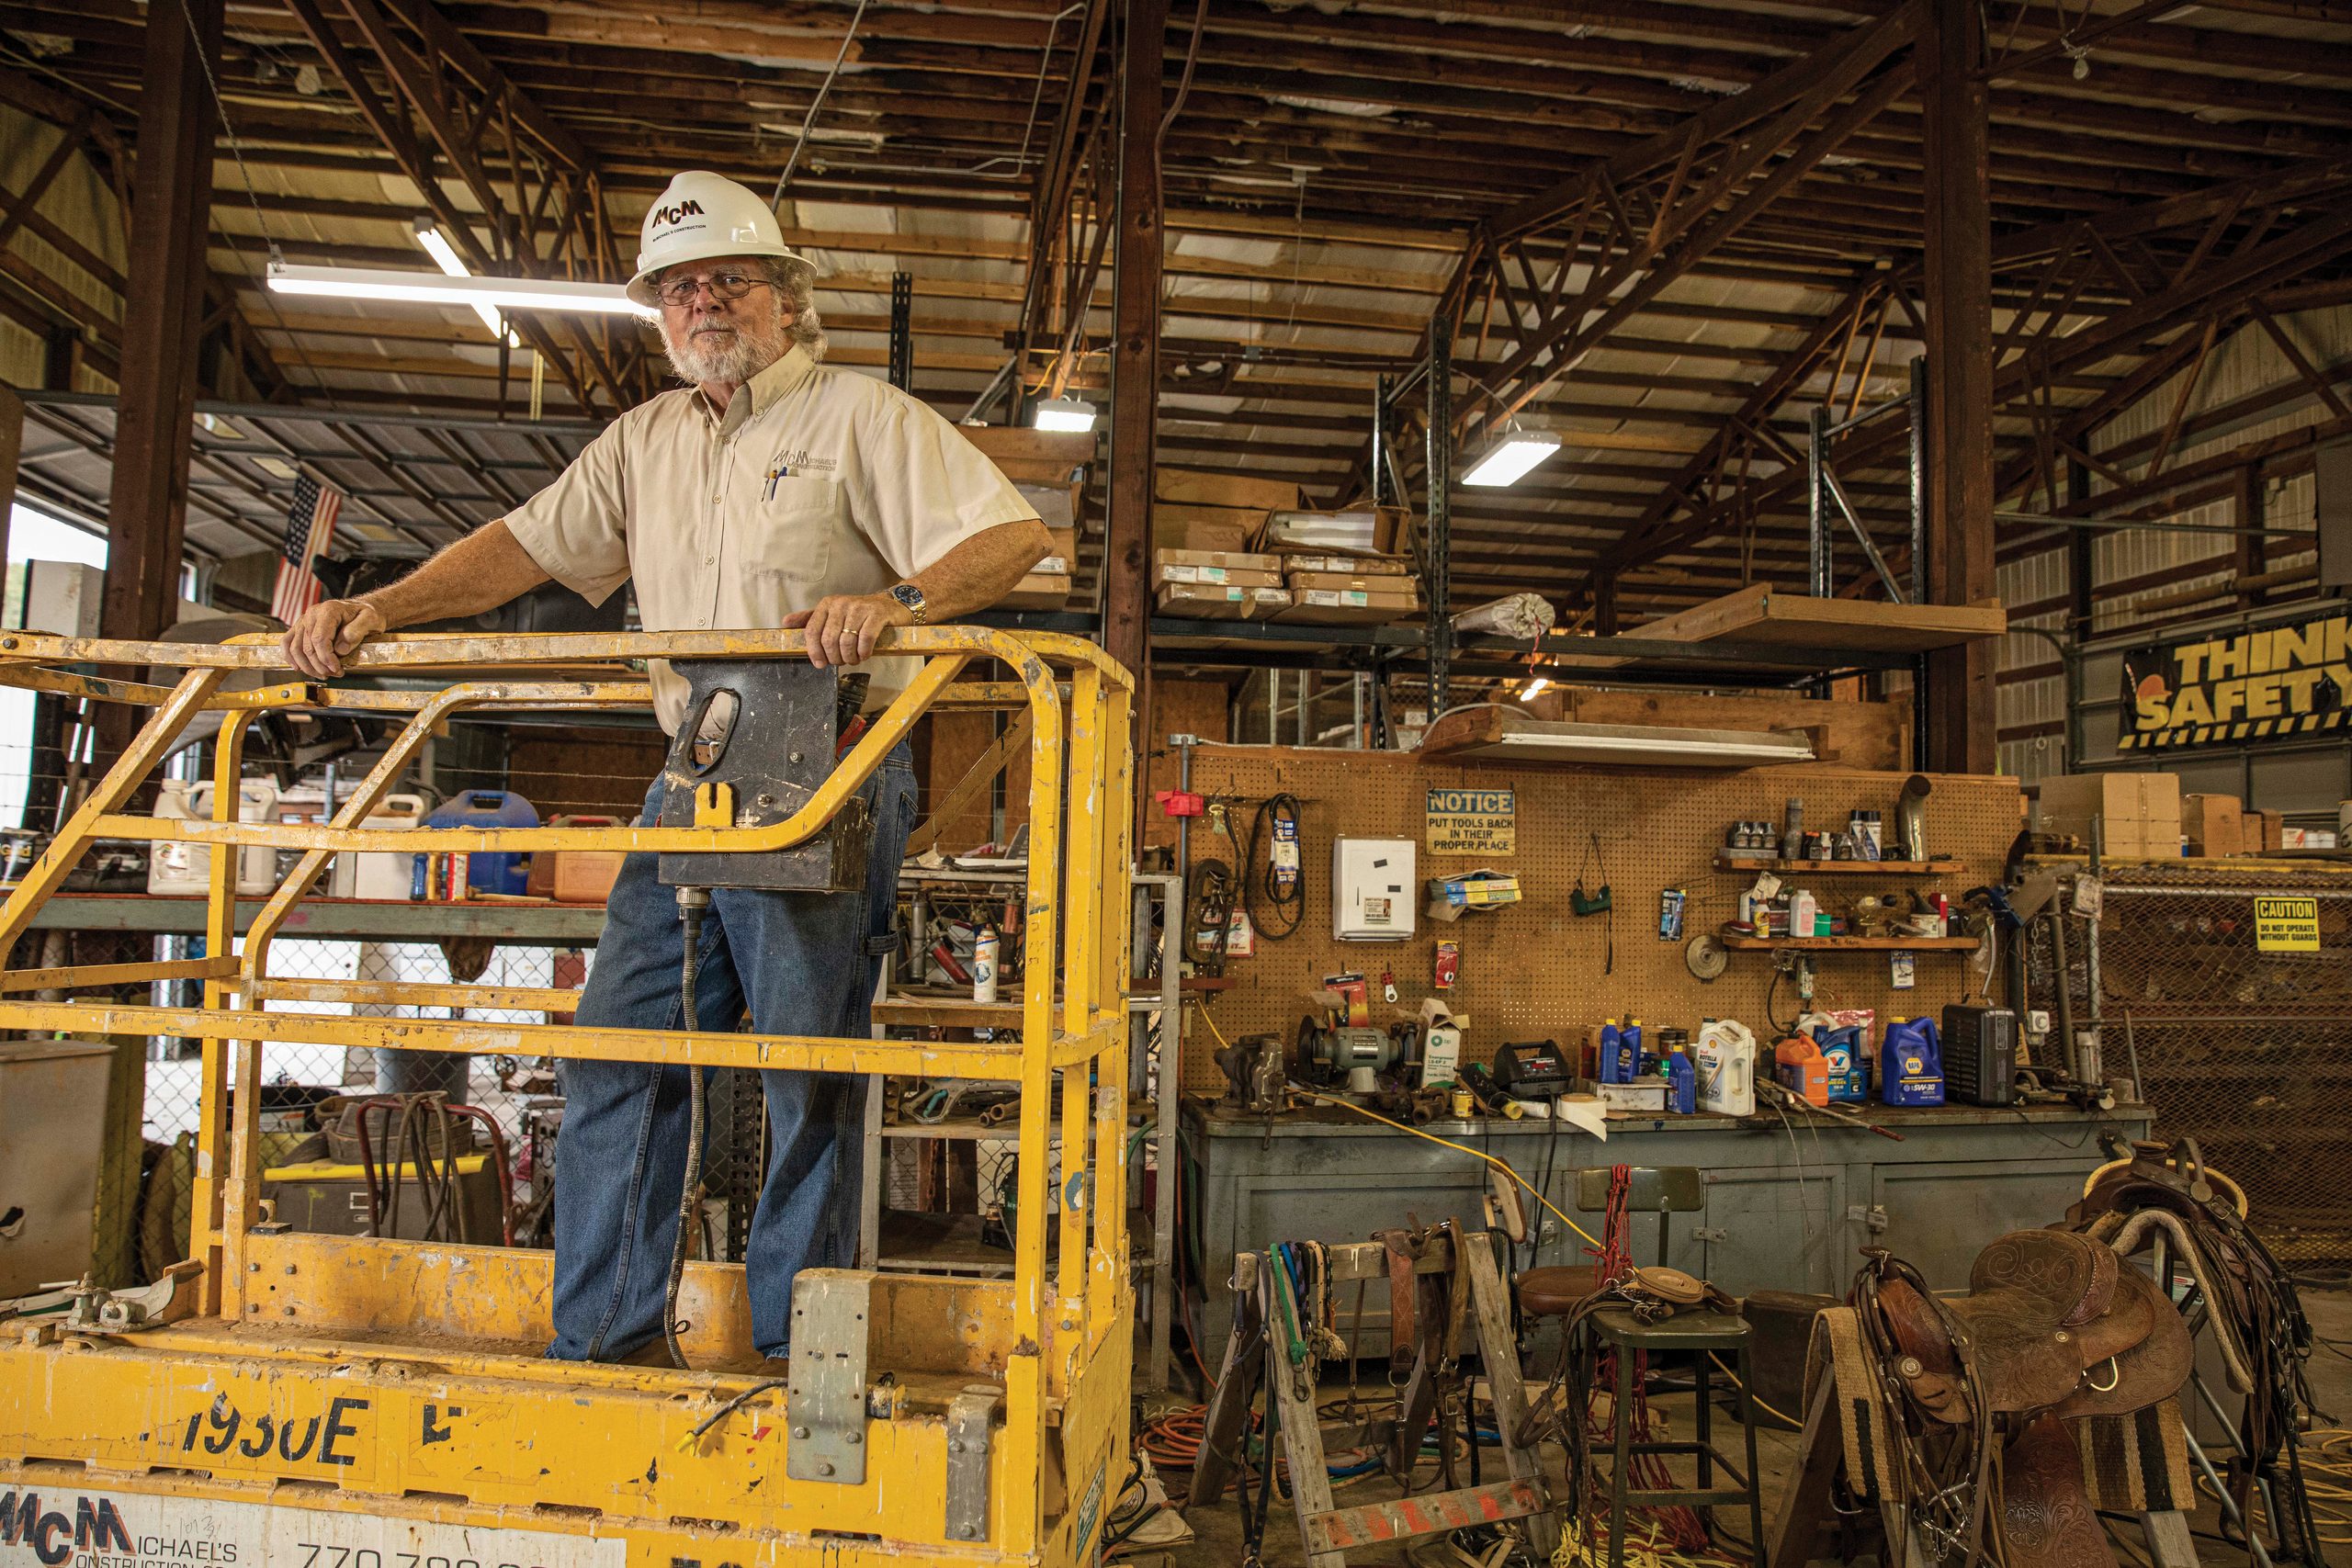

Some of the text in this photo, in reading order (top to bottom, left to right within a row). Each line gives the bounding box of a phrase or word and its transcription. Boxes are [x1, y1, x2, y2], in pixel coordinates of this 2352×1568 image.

[674, 225, 707, 233] CONSTRUCTION
[2174, 616, 2352, 684] THINK
[2135, 663, 2352, 731] SAFETY
[1429, 793, 1511, 812] NOTICE
[1429, 818, 1514, 828] PUT TOOLS BACK
[1450, 829, 1493, 839] IN THEIR
[1434, 840, 1509, 851] PROPER PLACE
[2259, 901, 2313, 918] CAUTION
[2287, 924, 2315, 932] OPERATE
